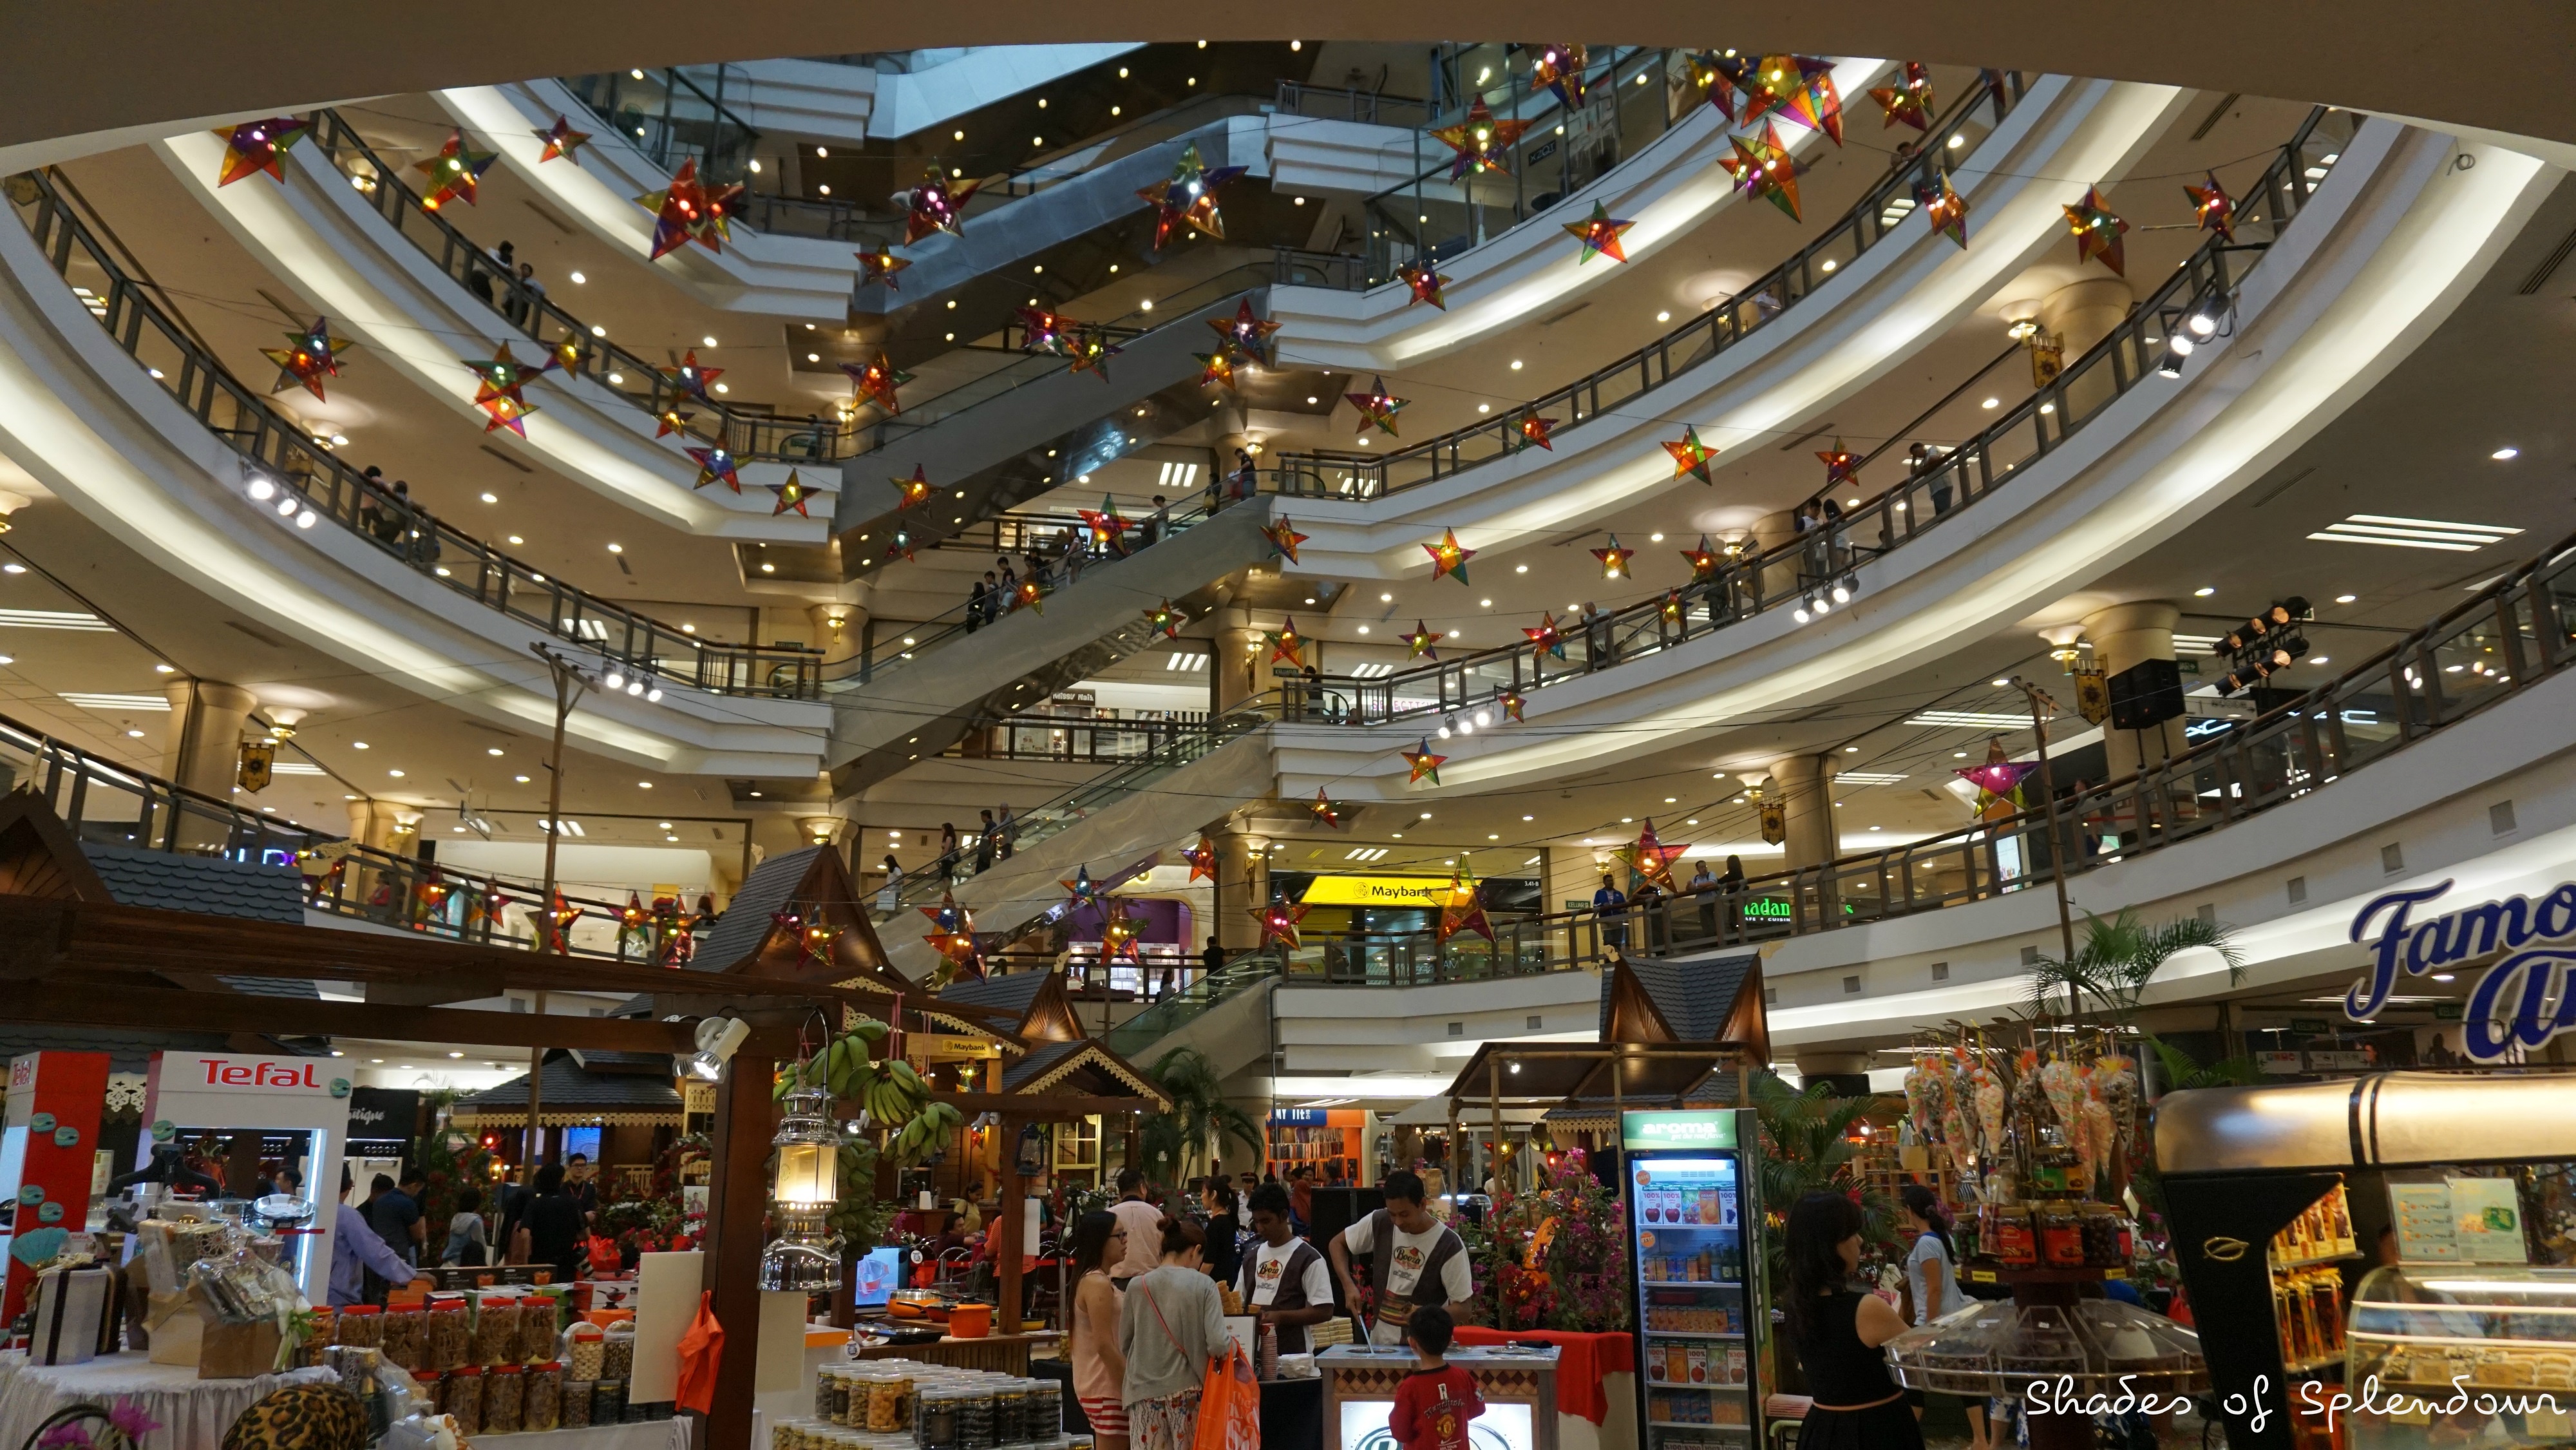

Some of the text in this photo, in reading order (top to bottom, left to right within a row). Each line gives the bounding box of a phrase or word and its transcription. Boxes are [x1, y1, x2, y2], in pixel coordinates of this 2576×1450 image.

[1372, 885, 1433, 898] Maybank
[2345, 877, 2576, 1022] Famo
[954, 1043, 986, 1051] Maybank
[199, 1060, 321, 1088] Tefal
[1642, 1121, 1716, 1134] aroma
[1396, 1248, 1421, 1264] Booza
